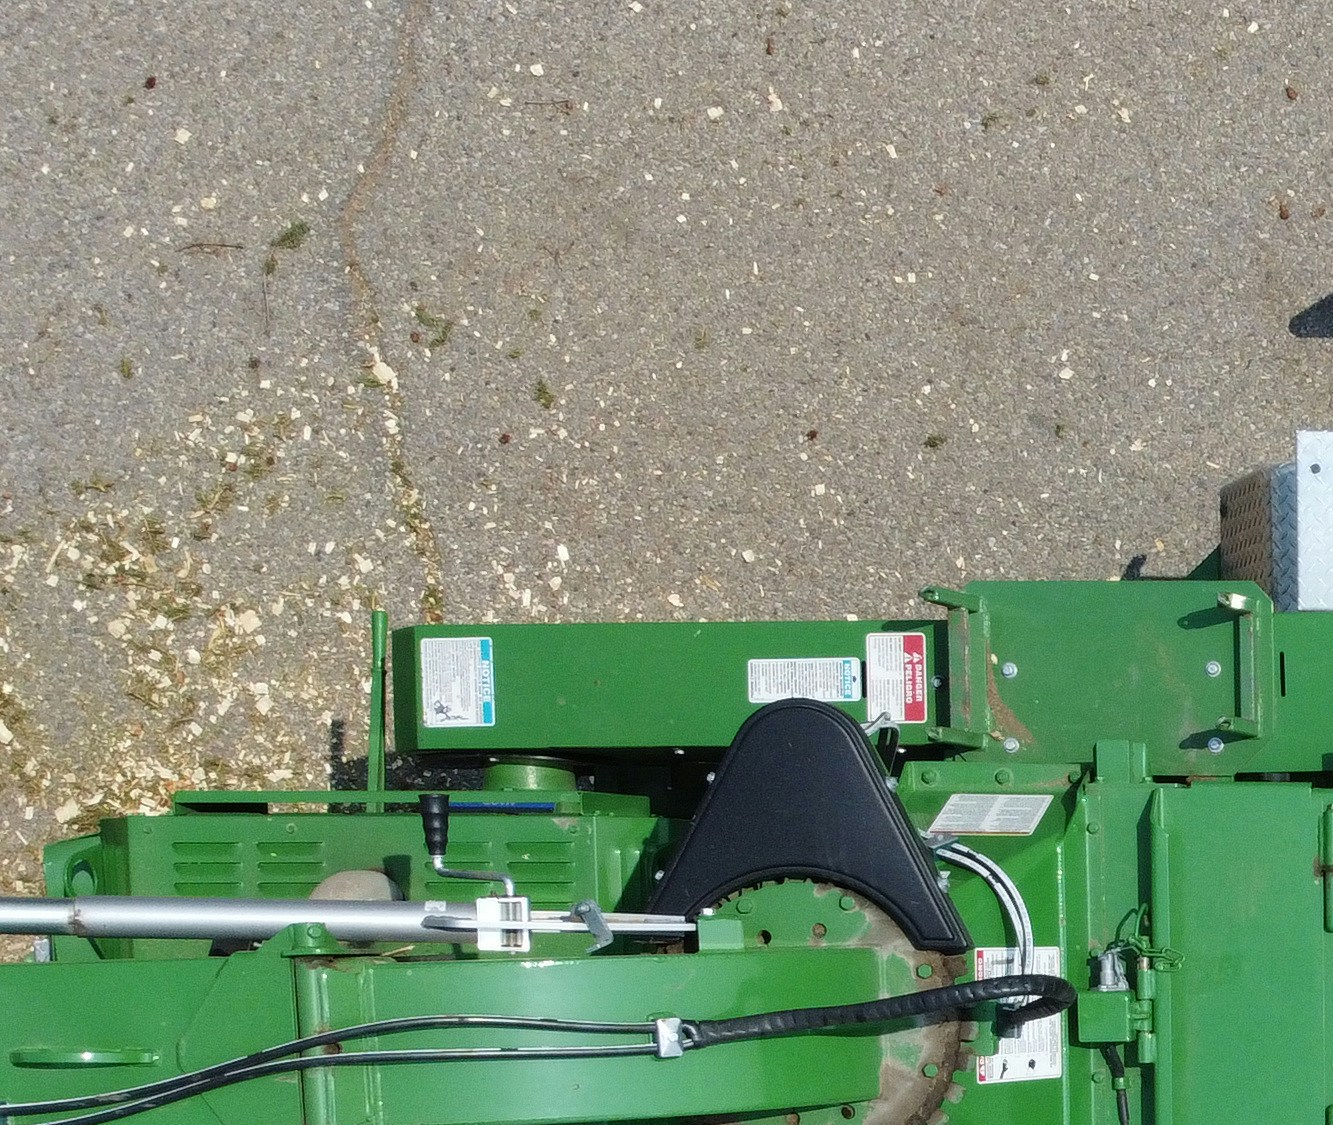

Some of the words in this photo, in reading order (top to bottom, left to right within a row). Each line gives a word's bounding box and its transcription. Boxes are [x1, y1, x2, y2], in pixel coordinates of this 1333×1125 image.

[482, 660, 491, 701] NOTICE
[844, 663, 852, 696] NOTICE
[905, 664, 913, 704] PELIGRO
[914, 664, 923, 702] DANGER
